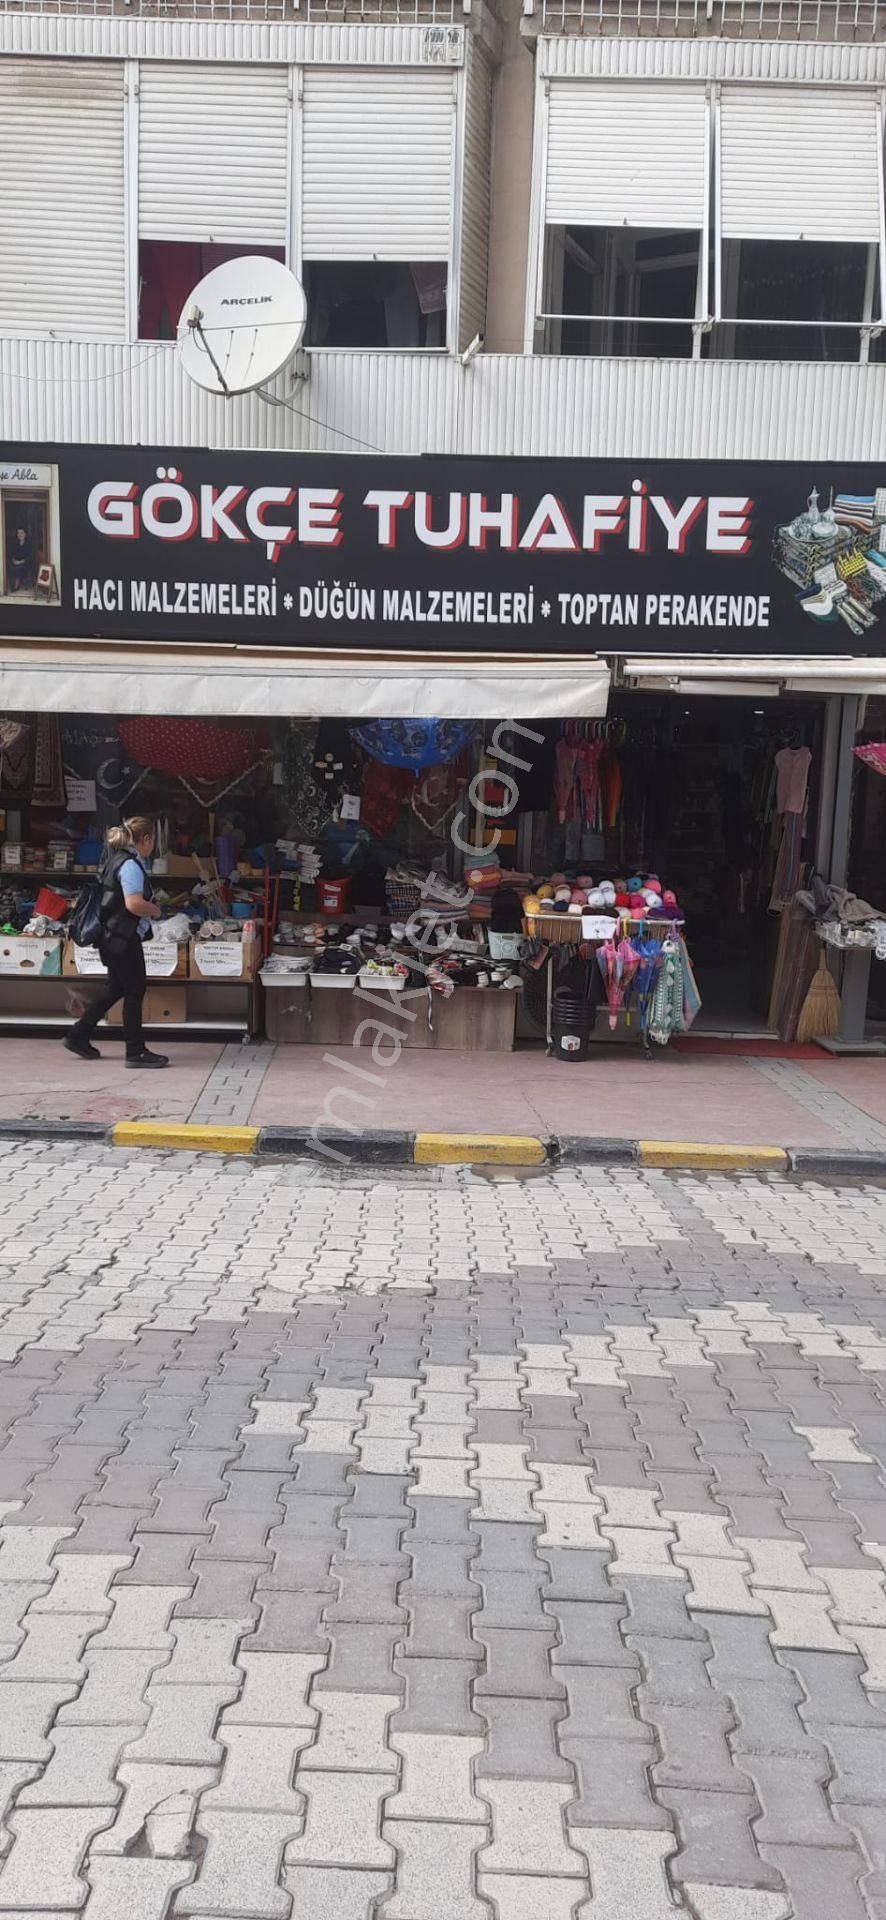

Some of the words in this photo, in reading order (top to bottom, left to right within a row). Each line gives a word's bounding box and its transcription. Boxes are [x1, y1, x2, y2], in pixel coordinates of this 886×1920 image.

[11, 467, 39, 481] Abla
[87, 466, 344, 562] GÖKÇE
[363, 479, 754, 553] TUHAFİYE
[73, 578, 123, 612] HACI
[130, 577, 277, 617] MALZEMELERİ
[299, 580, 376, 621] DÜĞÜN
[382, 585, 534, 624] MALZEMELERİ
[557, 592, 639, 626] TOPTAN
[645, 594, 771, 627] PERAKENDE
